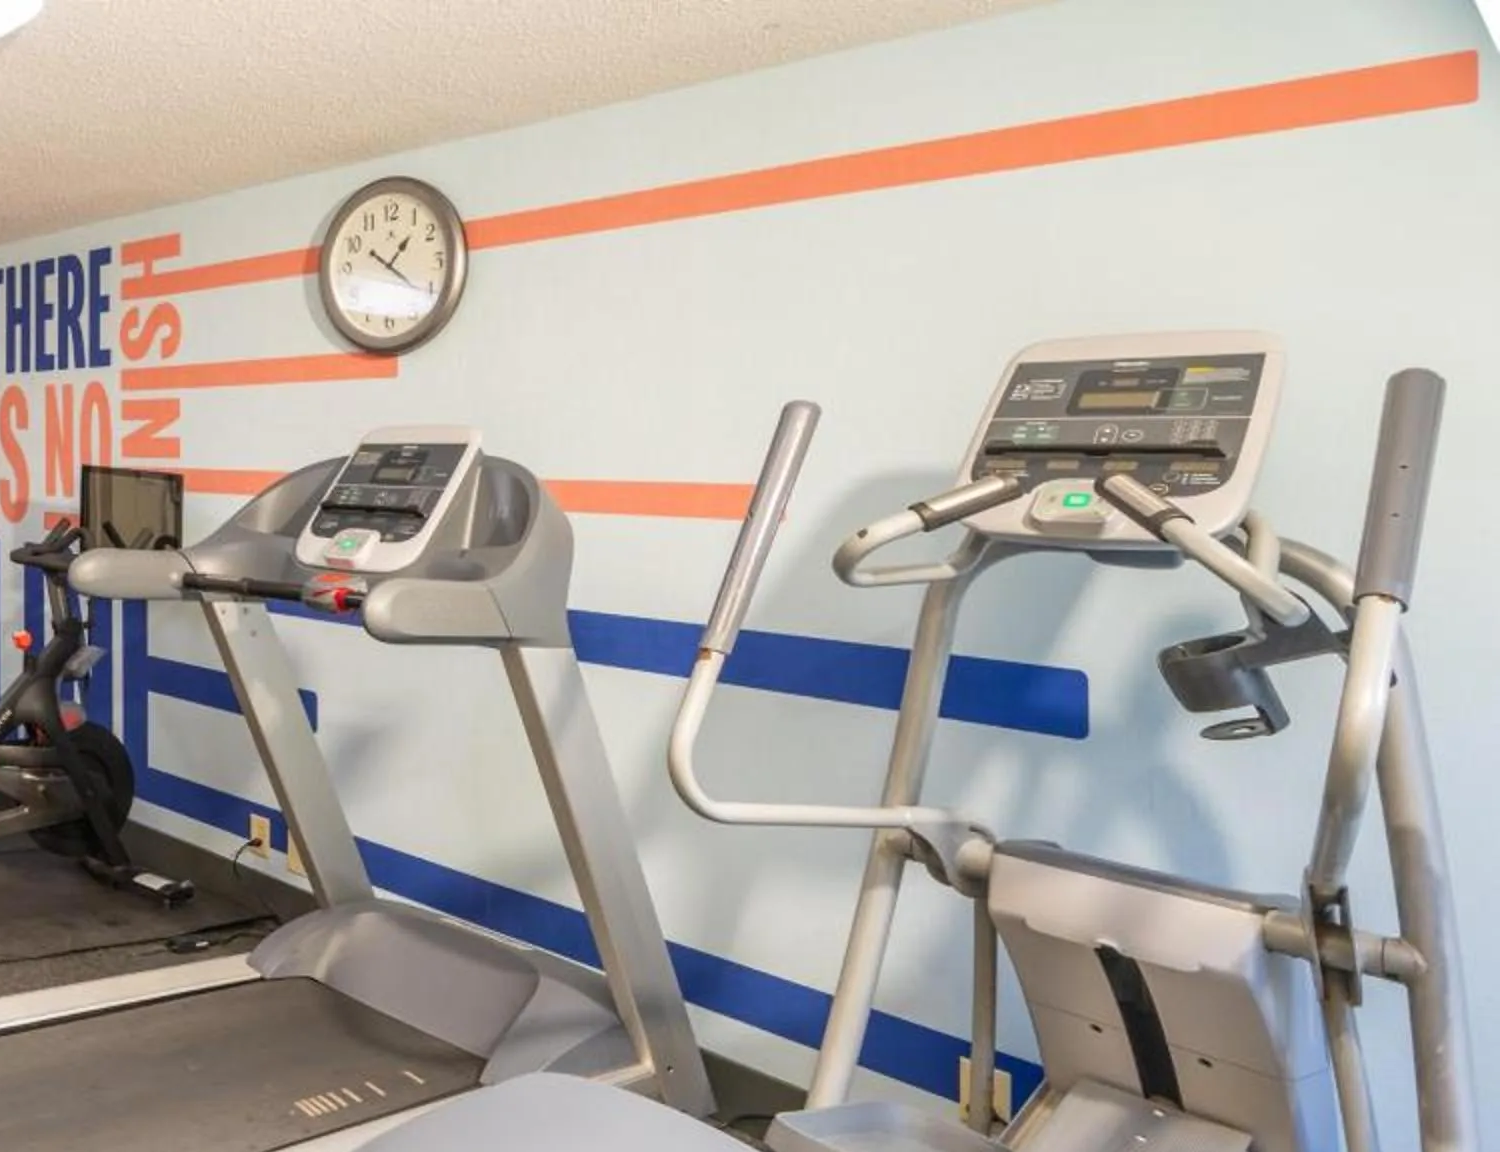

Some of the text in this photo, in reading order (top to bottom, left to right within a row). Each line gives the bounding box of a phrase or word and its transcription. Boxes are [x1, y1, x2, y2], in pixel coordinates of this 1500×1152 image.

[363, 212, 375, 231] 11
[384, 203, 400, 222] 12
[411, 207, 417, 226] 1
[425, 223, 436, 242] 2
[348, 234, 362, 253] 10
[44, 380, 113, 499] NO
